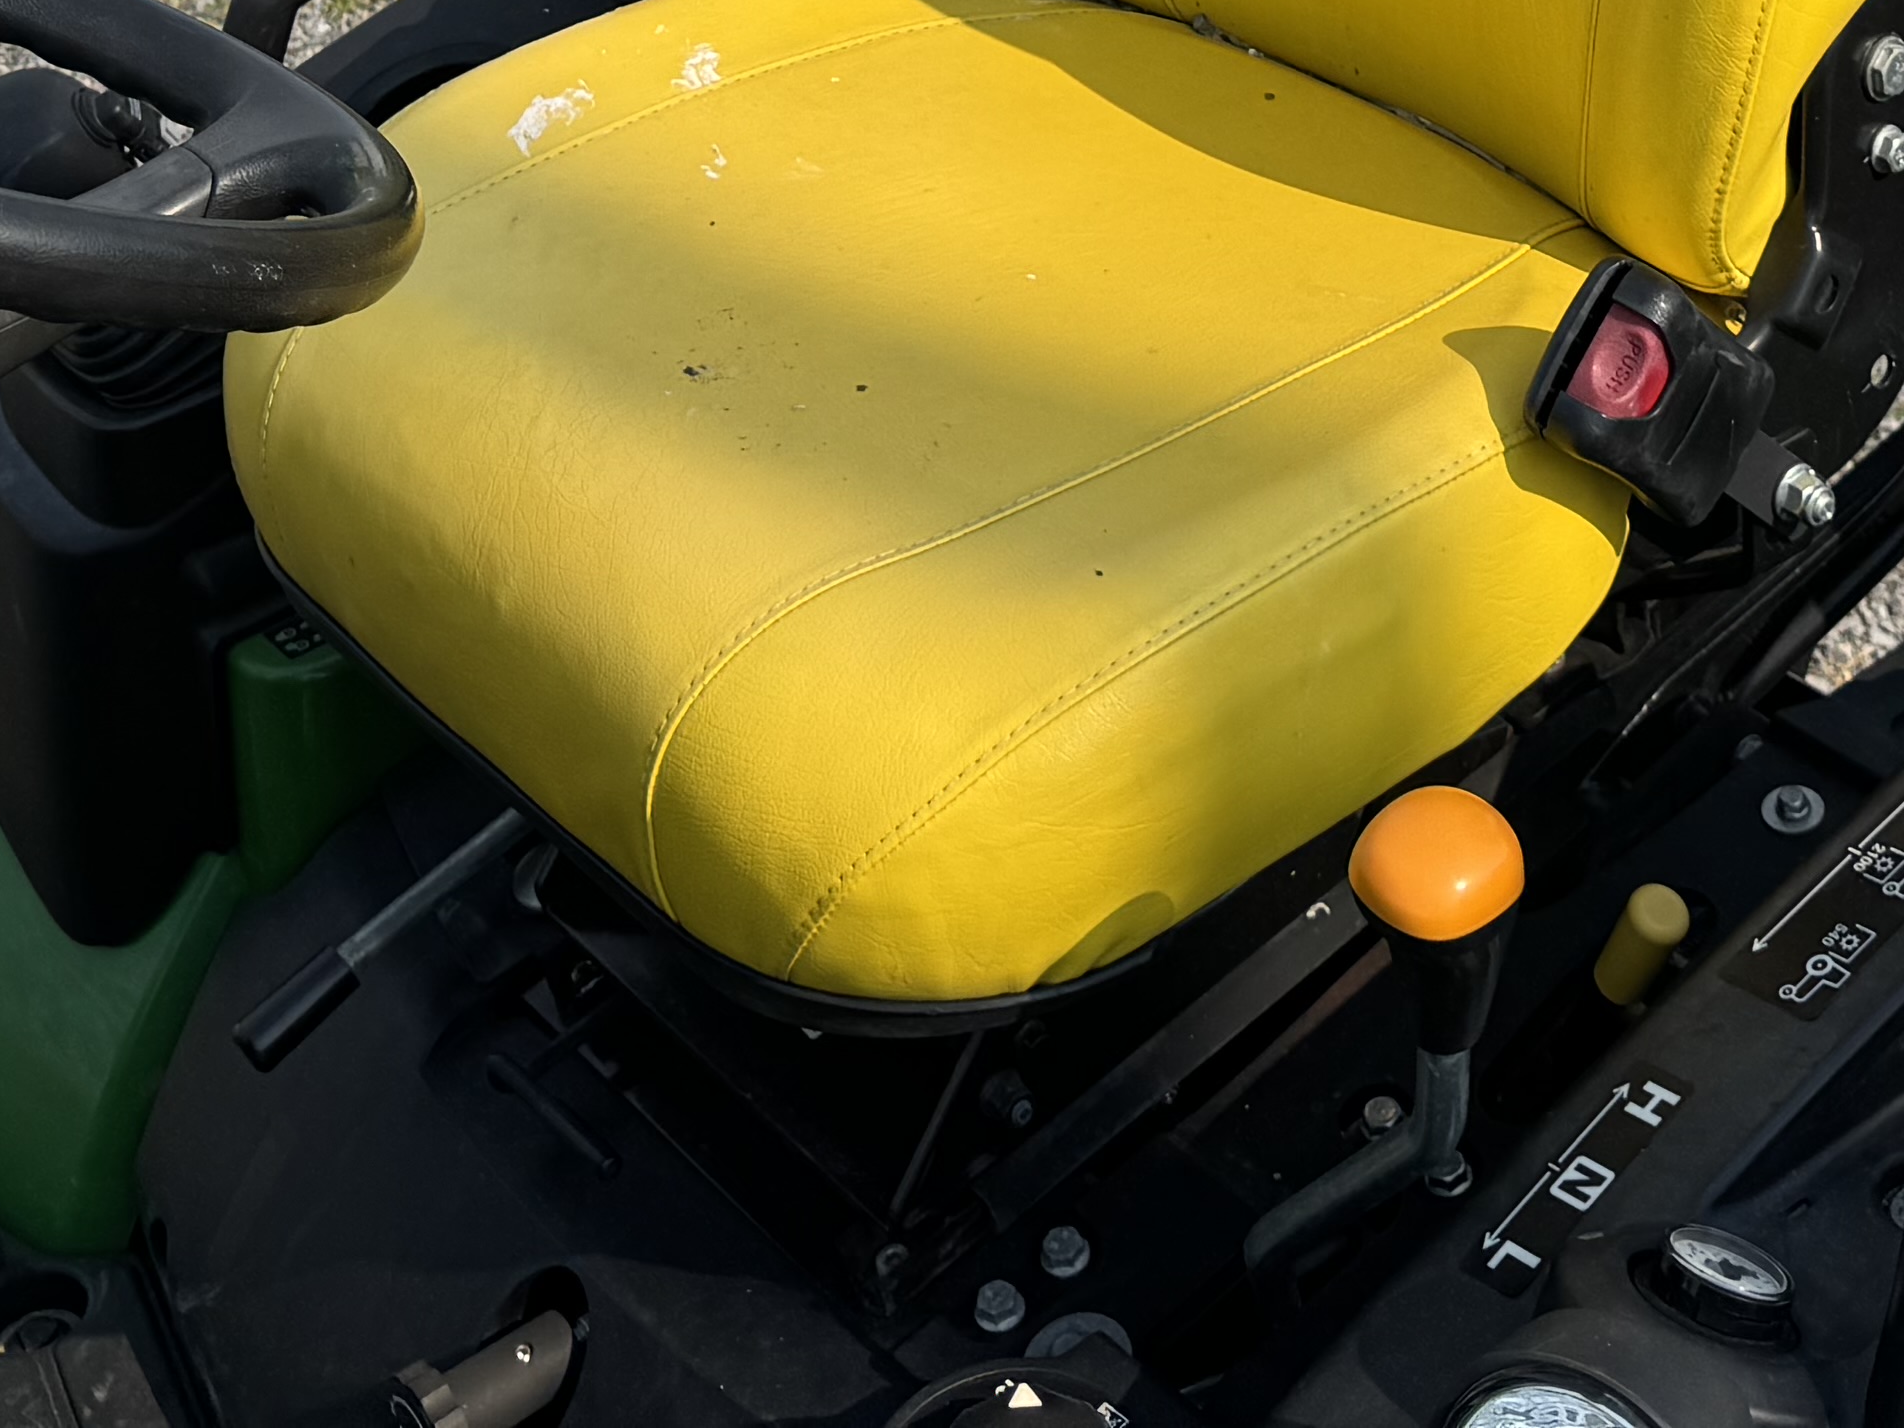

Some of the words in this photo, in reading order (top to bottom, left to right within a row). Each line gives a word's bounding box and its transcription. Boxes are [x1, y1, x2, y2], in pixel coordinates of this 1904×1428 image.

[1605, 337, 1642, 393] PUSH
[1853, 842, 1886, 872] 2100
[1822, 923, 1848, 947] 540
[1624, 1080, 1682, 1128] H
[1557, 1162, 1608, 1204] N
[1486, 1240, 1542, 1270] L
